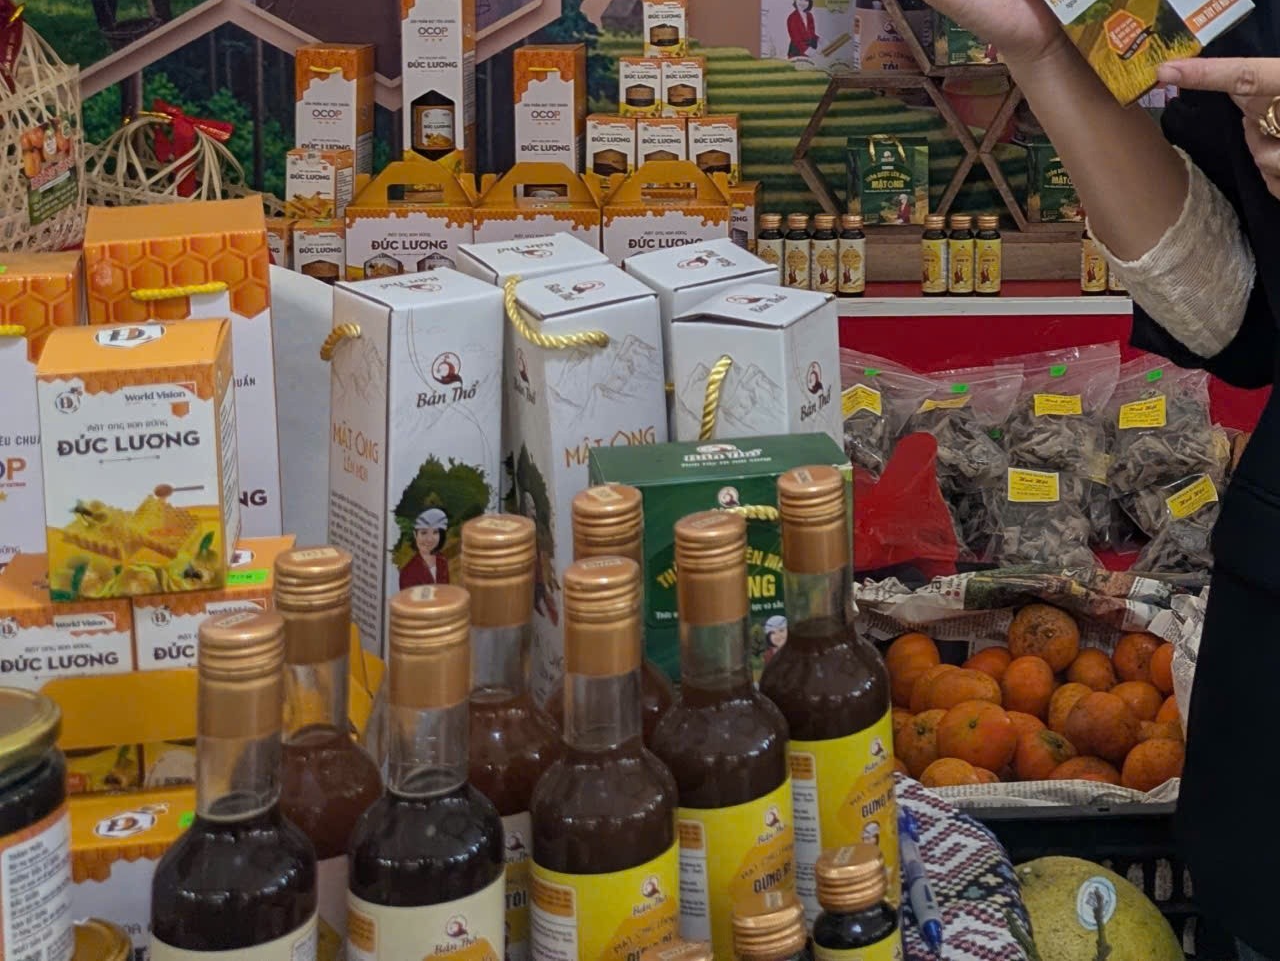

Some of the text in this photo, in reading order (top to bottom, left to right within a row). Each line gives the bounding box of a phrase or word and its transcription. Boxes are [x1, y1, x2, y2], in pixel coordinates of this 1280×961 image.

[417, 26, 449, 36] OCOP
[408, 59, 458, 68] ĐỨC LƯƠNG
[312, 109, 342, 118] OCOP
[531, 110, 560, 119] OCOP
[521, 143, 570, 152] ĐỨC LƯƠNG
[371, 238, 449, 250] ĐỨC LƯƠNG
[628, 238, 653, 249] ĐỨC
[125, 390, 186, 402] World Vision
[416, 380, 480, 408] Bản Thổ
[800, 401, 817, 422] Bản
[57, 430, 201, 457] ĐỨC LƯƠNG
[747, 574, 776, 598] NG
[153, 642, 195, 661] ĐỨC
[0, 651, 119, 673] ĐỨC LƯƠNG
